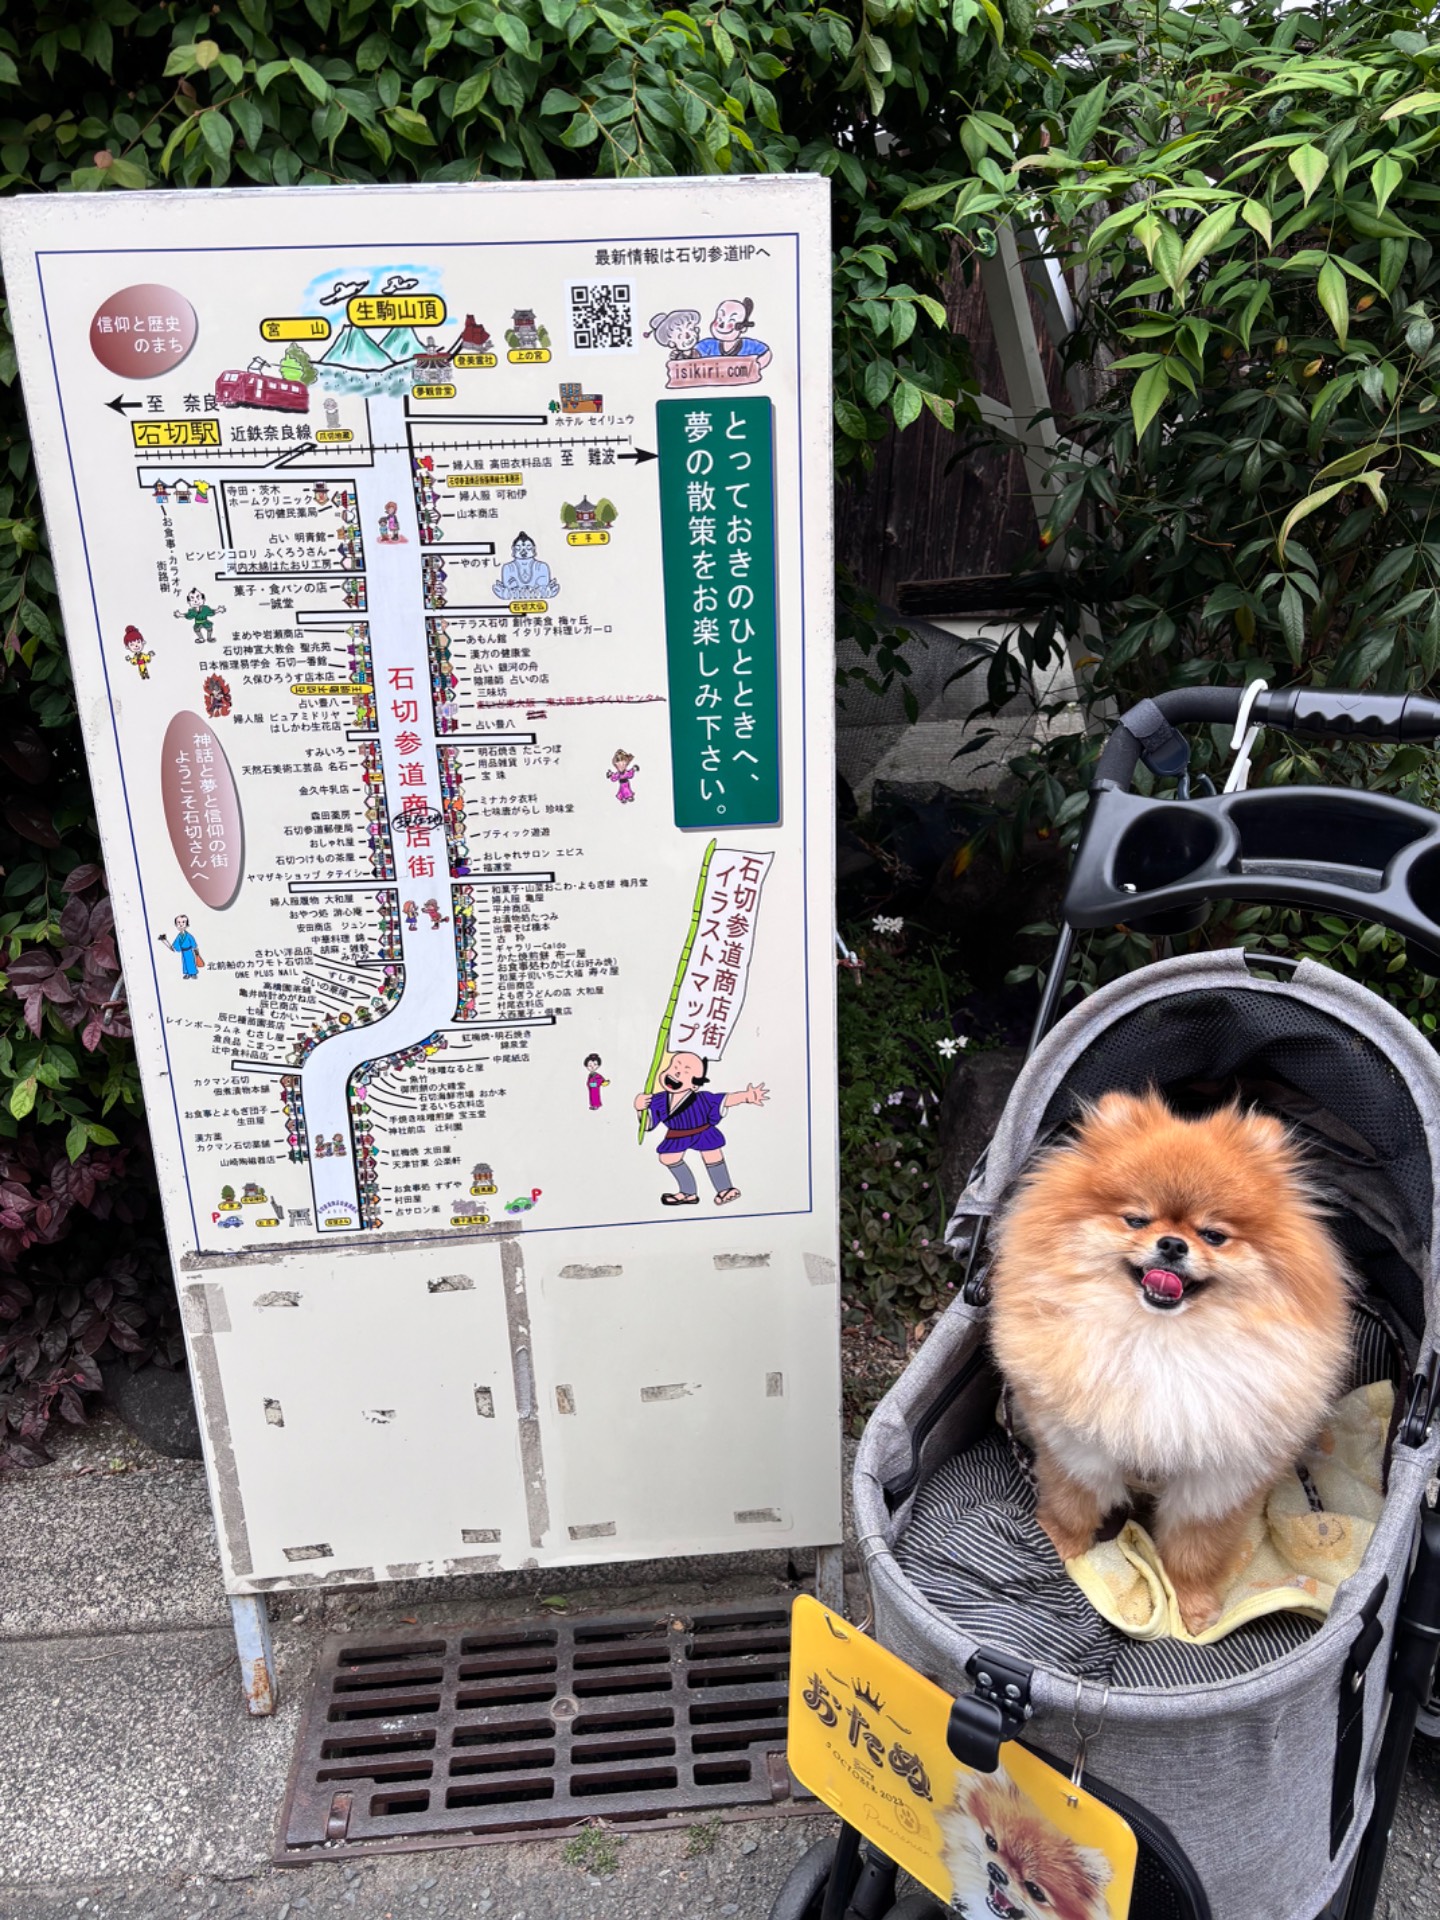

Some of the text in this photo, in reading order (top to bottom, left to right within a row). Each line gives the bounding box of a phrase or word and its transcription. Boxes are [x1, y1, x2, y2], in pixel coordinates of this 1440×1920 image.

[595, 245, 771, 266] 最新情報は石切参道HPへ
[356, 300, 438, 321] 生駒山頂
[97, 315, 182, 334] 信仰と歴史
[134, 337, 184, 354] のまち
[516, 351, 543, 362] 上の宮
[416, 386, 454, 397] 夢観音堂
[147, 393, 220, 412] 至 奈良
[554, 415, 635, 427] ホテル セイリュウ
[138, 422, 219, 445] 石切駅
[230, 424, 312, 442] 近鉄奈良線
[560, 448, 616, 466] 至 難波
[452, 457, 552, 471] 婦人服 高田衣料品店
[229, 495, 312, 507] ホームクリニック
[459, 490, 491, 501] 婦人服
[456, 508, 499, 520] 山本商店
[269, 533, 289, 544] 占い
[264, 547, 327, 558] ふくろうさん
[461, 558, 501, 569] やのすし
[156, 561, 171, 593] 街路樹
[458, 618, 508, 629] テラス石切
[466, 634, 507, 646] あもん館
[470, 648, 531, 660] 漢方の健康堂
[473, 663, 493, 674] 占い
[510, 674, 550, 685] 占いの店
[233, 713, 264, 725] 婦人服
[270, 722, 341, 734] はしかわ生花店
[305, 747, 345, 758] すみいろ
[523, 744, 561, 754] たこつぼ
[328, 761, 348, 772] 名石
[388, 667, 435, 879] 石切参道商店街
[193, 733, 229, 869] 神話と夢と信仰の街
[480, 793, 538, 805] ミナカタ衣料
[176, 750, 210, 880] ようこそ石切さんへ
[283, 824, 354, 836] 石切参道郵便局
[309, 838, 355, 849] おしゃれ屋
[275, 853, 356, 866] 石切つけもの茶屋
[483, 850, 550, 862] おしゃれサロン
[327, 870, 363, 879] タテイシ
[325, 894, 354, 904] 大和屋
[491, 895, 520, 905] 婦人服
[678, 865, 735, 1043] イラストマップ
[702, 856, 764, 1049] 石切参道商店街
[235, 968, 299, 980] ONE PLUS NAIL
[576, 986, 604, 996] 大和屋
[247, 1006, 298, 1021] 七味 むかい
[247, 1039, 276, 1051] こまつ
